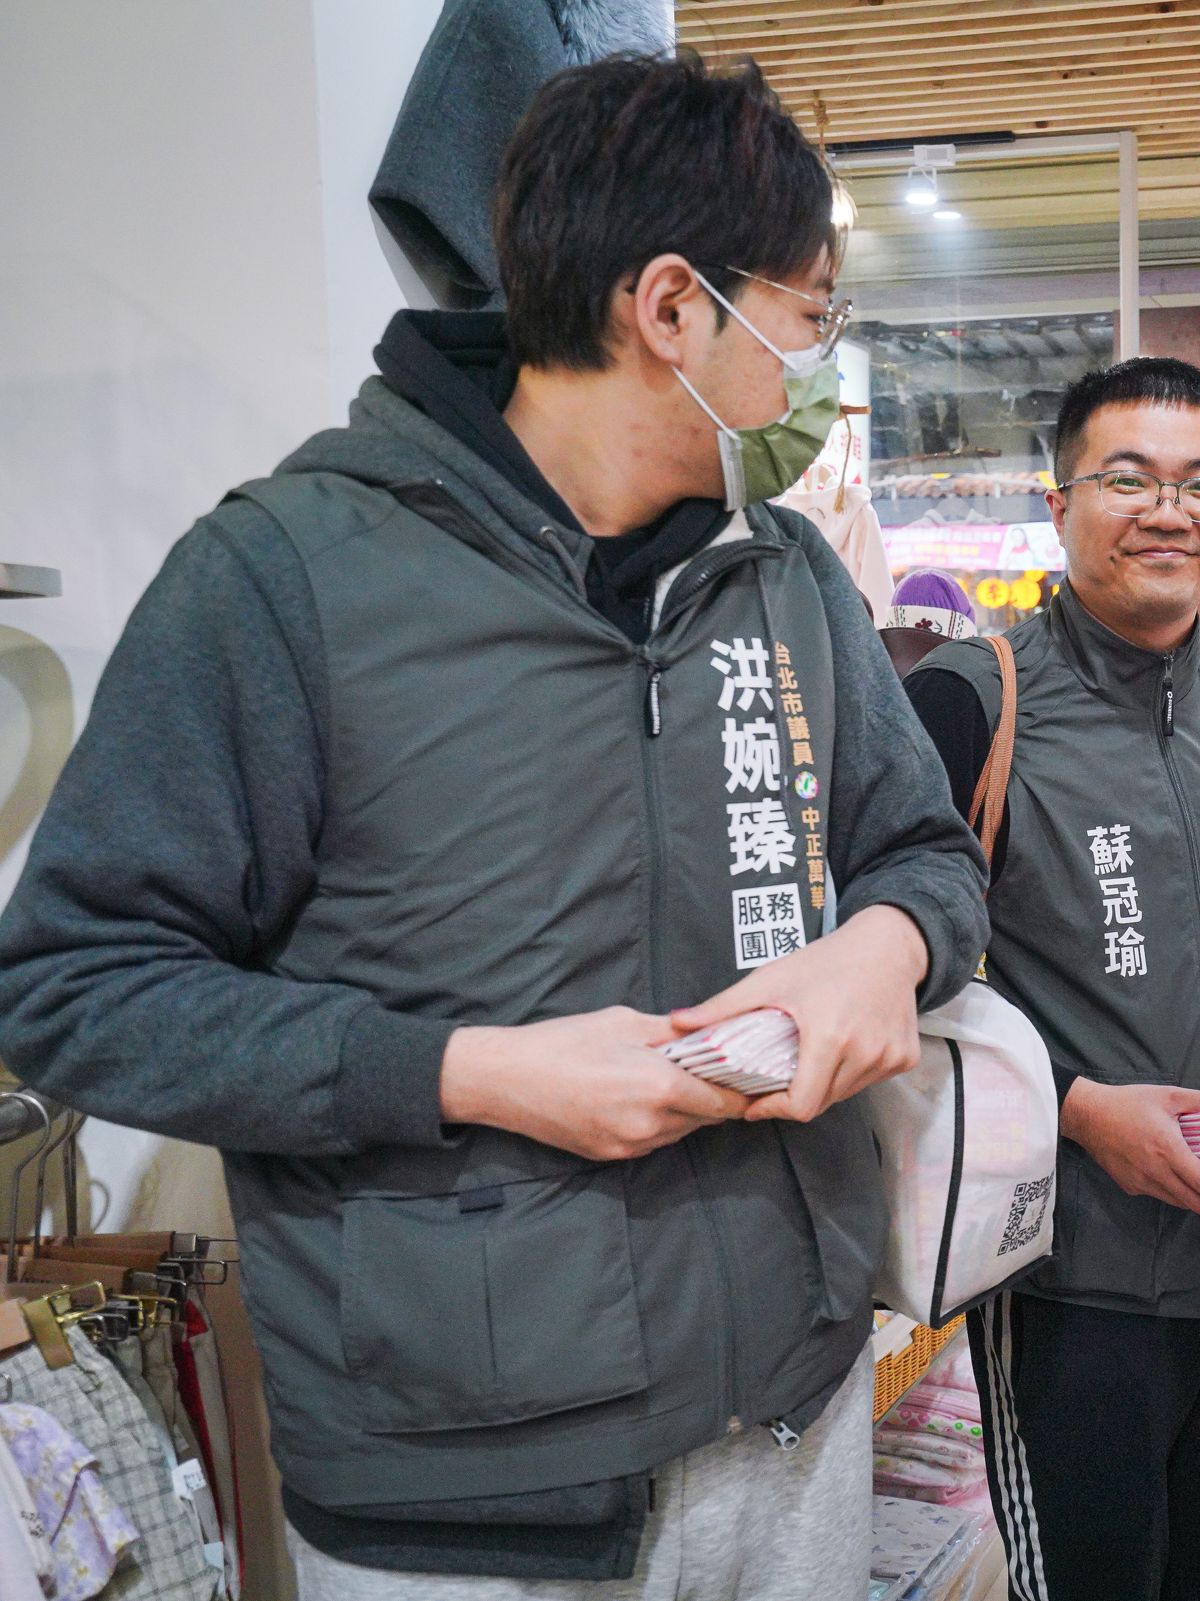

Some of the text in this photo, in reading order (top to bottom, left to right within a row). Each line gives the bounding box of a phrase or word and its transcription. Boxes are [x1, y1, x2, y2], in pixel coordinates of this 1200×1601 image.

[709, 637, 797, 876] 洪婉臻
[774, 640, 825, 910] 台北市議員 中正萬華
[1086, 823, 1148, 978] 蘇冠瑜
